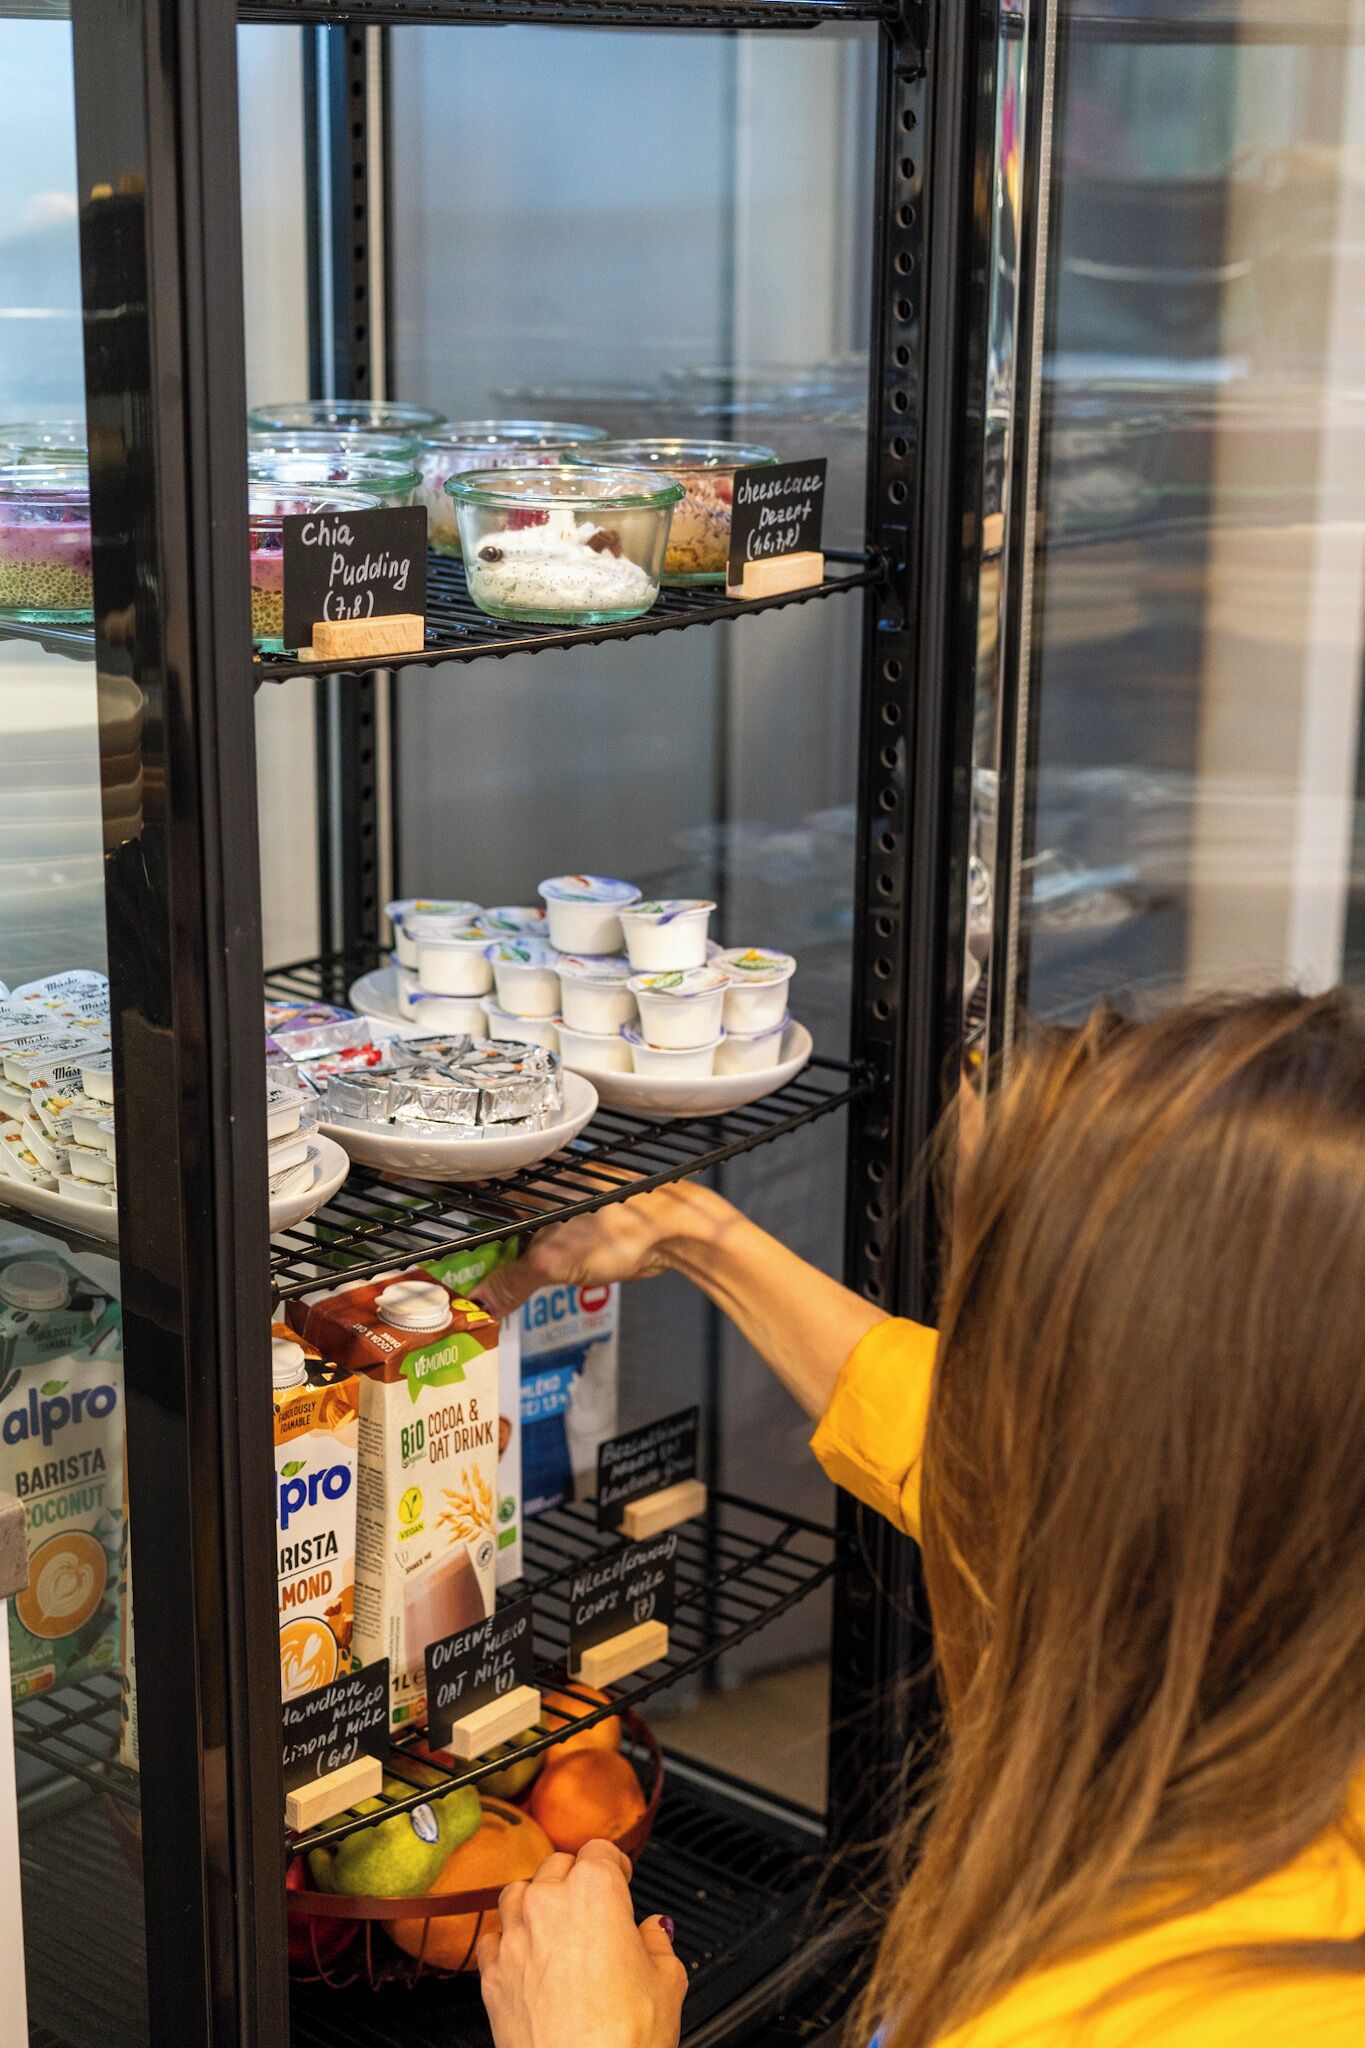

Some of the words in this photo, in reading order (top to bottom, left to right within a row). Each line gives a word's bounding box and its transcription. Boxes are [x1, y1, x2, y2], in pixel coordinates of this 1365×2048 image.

[301, 516, 354, 546] Chia
[328, 552, 411, 591] Pudding
[323, 590, 374, 622] (7,8)
[79, 1000, 109, 1012] Másl
[52, 1066, 82, 1080] Más
[415, 1345, 458, 1378] VEMONDO
[3, 1385, 117, 1446] alpro
[278, 1402, 317, 1424] FABULOUSLY
[280, 1415, 311, 1434] FOAMABLE
[428, 1403, 464, 1437] COCOA
[469, 1399, 478, 1421] &
[430, 1434, 449, 1463] OAT
[455, 1421, 494, 1453] DRINK
[15, 1448, 106, 1498] BARISTA
[275, 1465, 352, 1531] pro
[400, 1523, 424, 1540] VEGAN
[278, 1530, 338, 1575] RISTA
[279, 1570, 332, 1612] MOND
[437, 1670, 468, 1708] OAT
